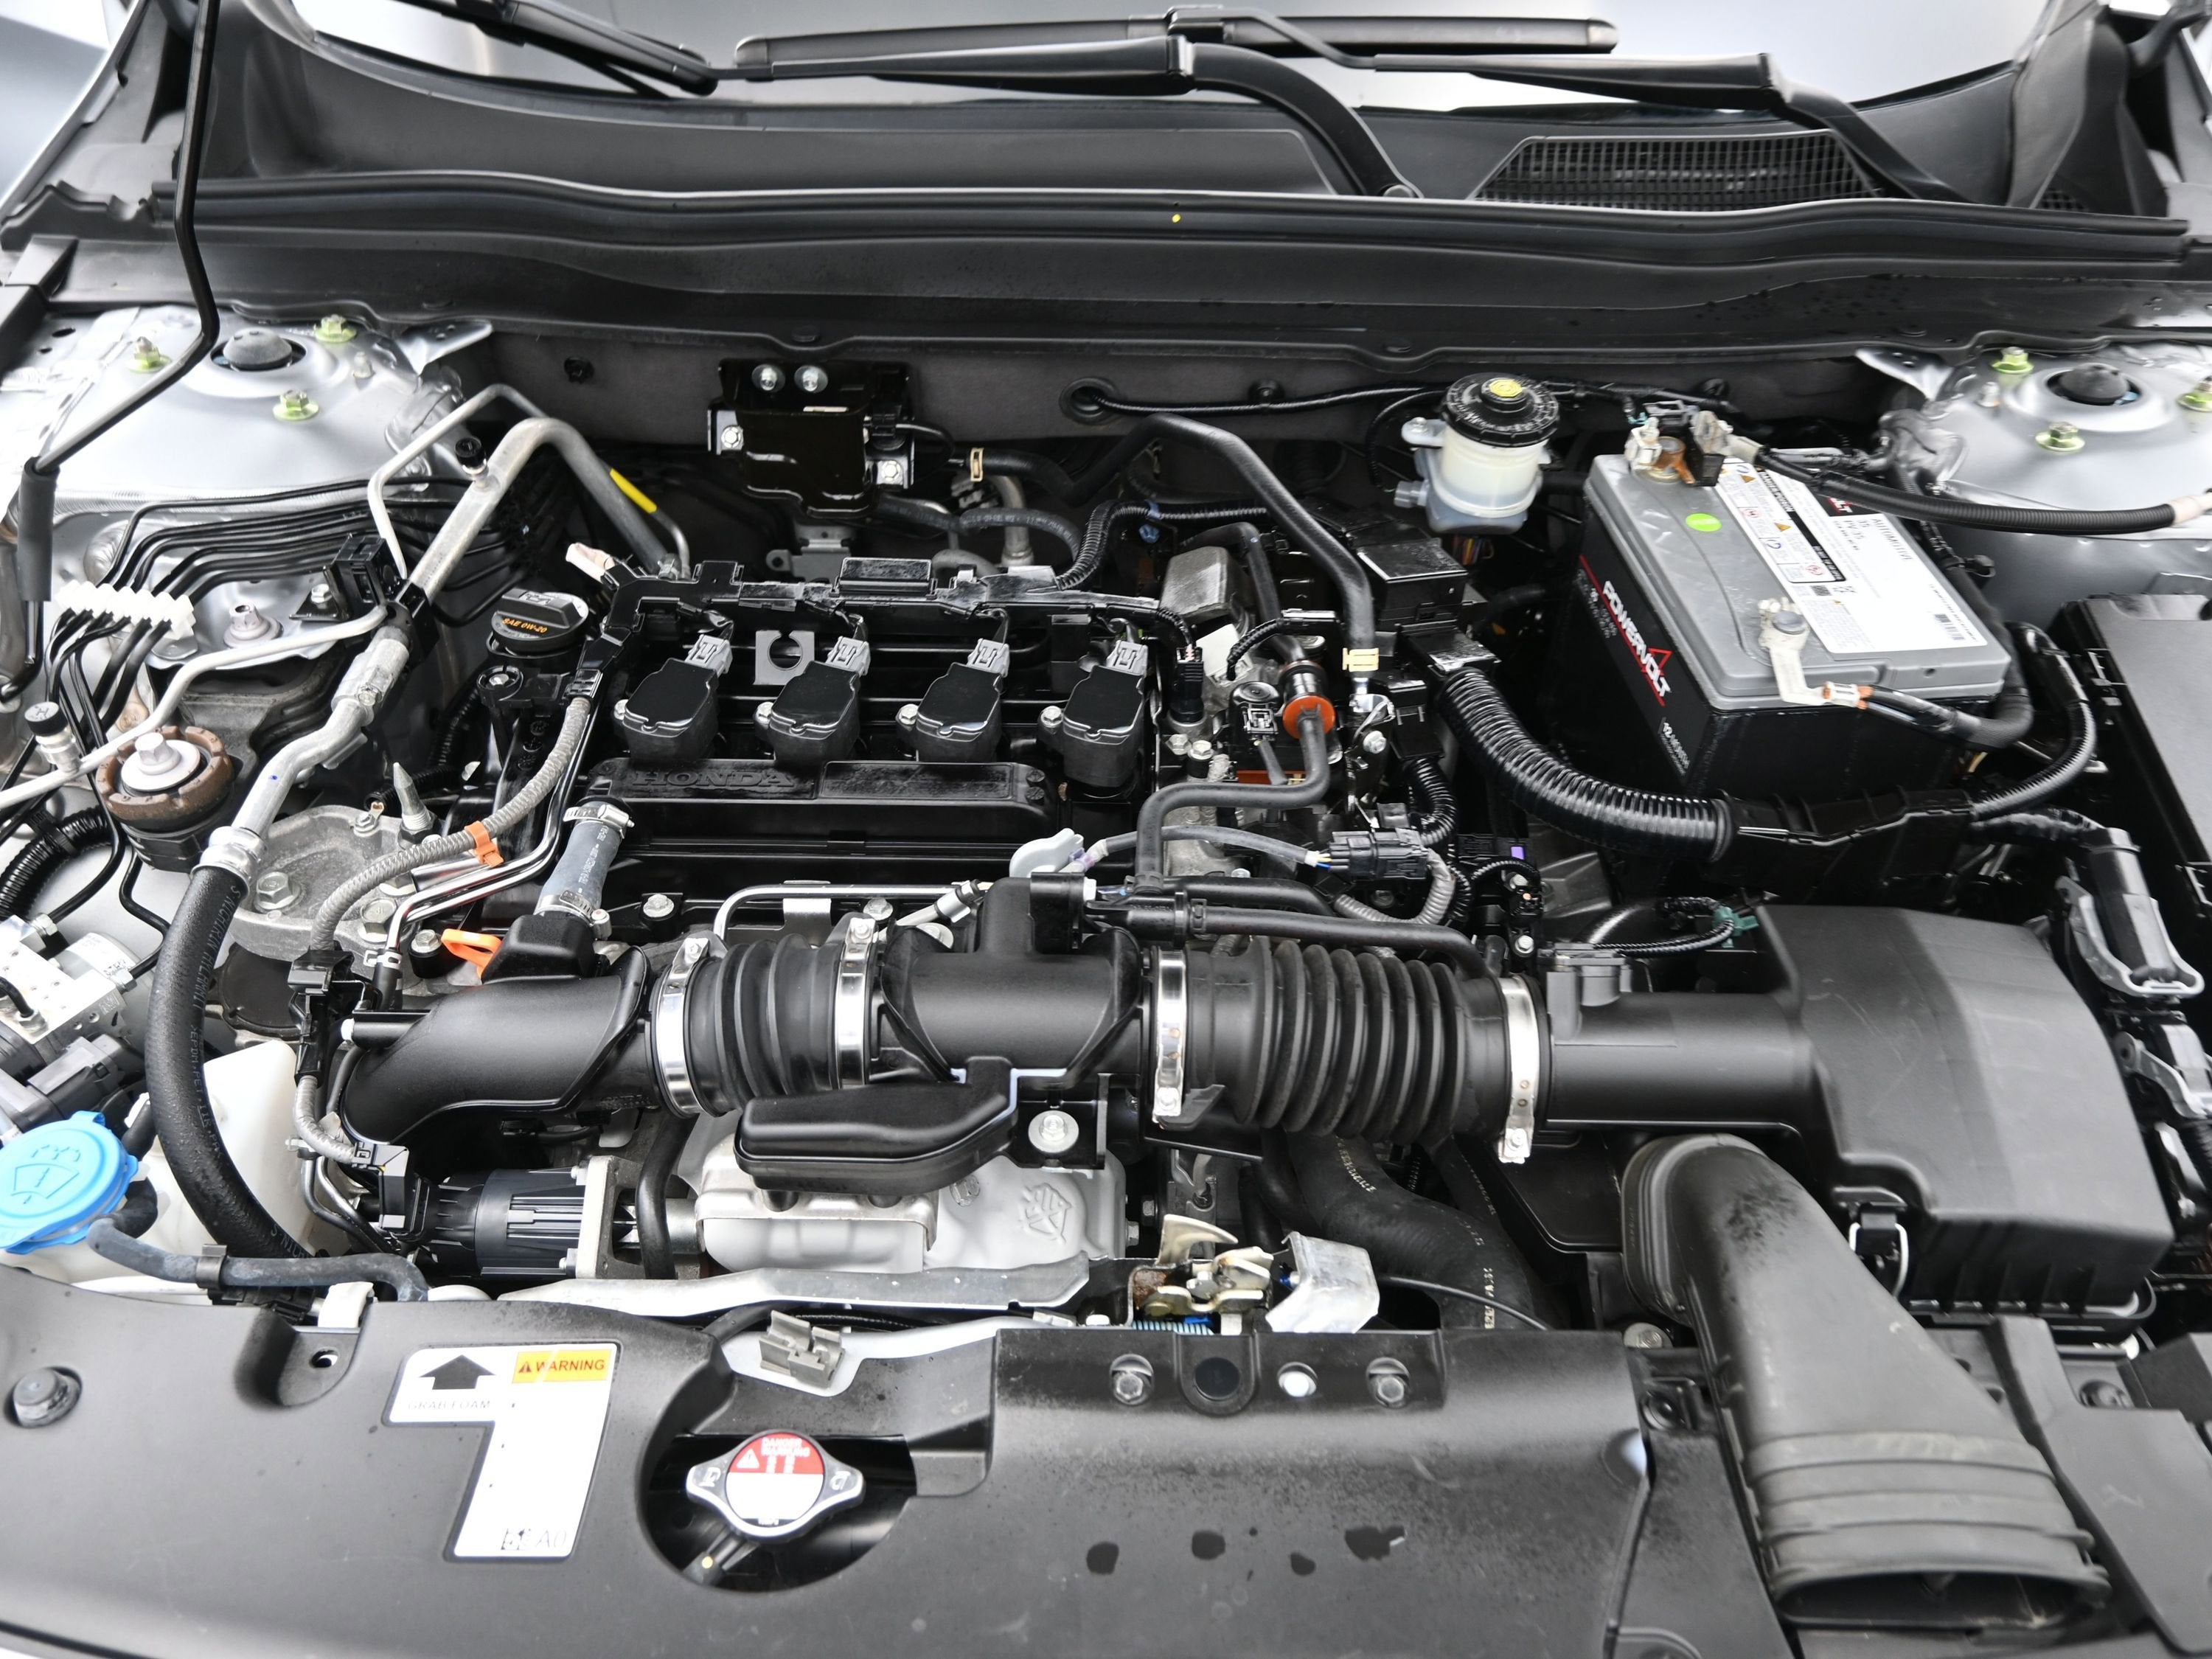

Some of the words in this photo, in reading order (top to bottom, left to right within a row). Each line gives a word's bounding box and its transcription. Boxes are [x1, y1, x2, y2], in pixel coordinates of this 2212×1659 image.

[502, 618, 521, 627] SAE
[521, 622, 548, 634] 0W-20
[1603, 581, 1672, 697] POWERVOLT
[633, 769, 794, 787] HONDA
[535, 1359, 605, 1372] WARNING
